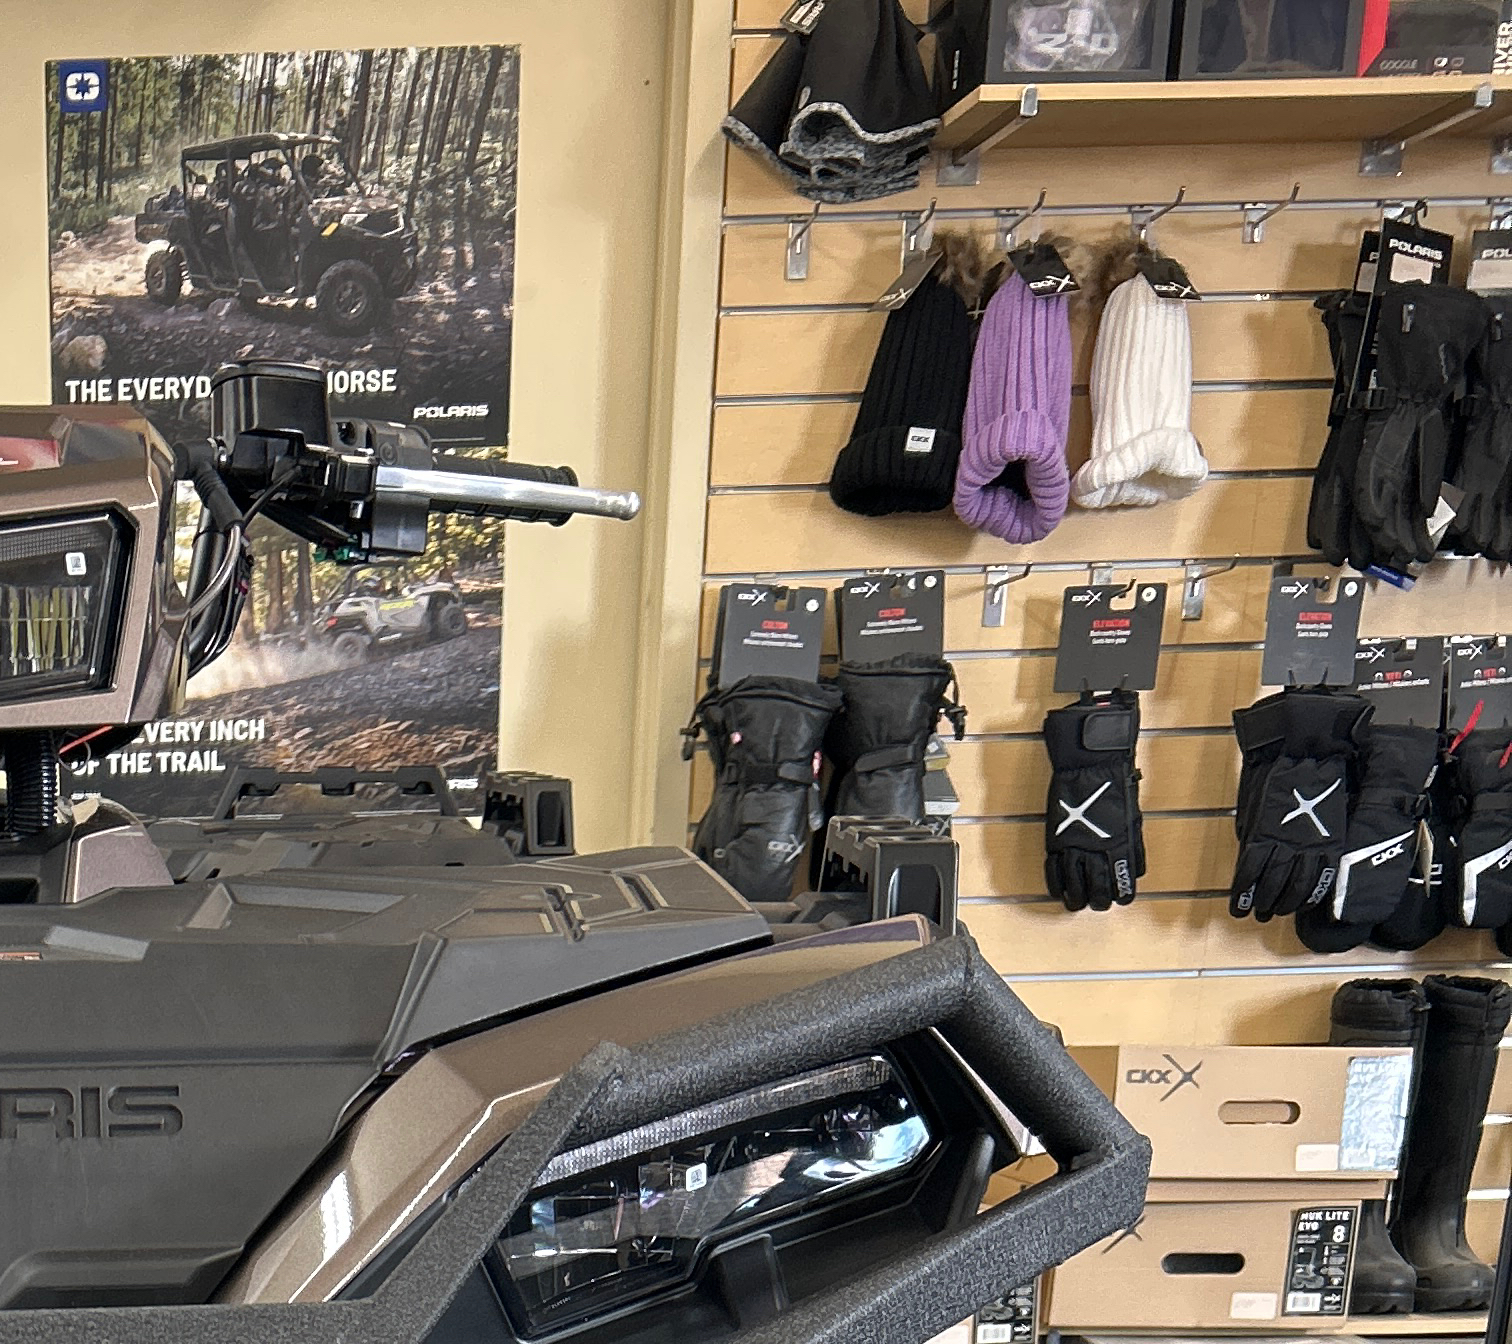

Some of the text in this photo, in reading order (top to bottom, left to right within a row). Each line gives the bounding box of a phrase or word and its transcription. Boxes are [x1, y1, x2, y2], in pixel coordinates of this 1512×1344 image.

[1389, 238, 1443, 261] POLARIS
[65, 379, 113, 403] THE
[117, 375, 214, 401] EVERYD
[413, 404, 489, 420] POLARIS
[210, 718, 265, 742] INCH
[106, 752, 152, 775] THE
[156, 750, 226, 774] TRAIL
[1372, 844, 1405, 866] CKX
[1333, 1224, 1346, 1243] 8
